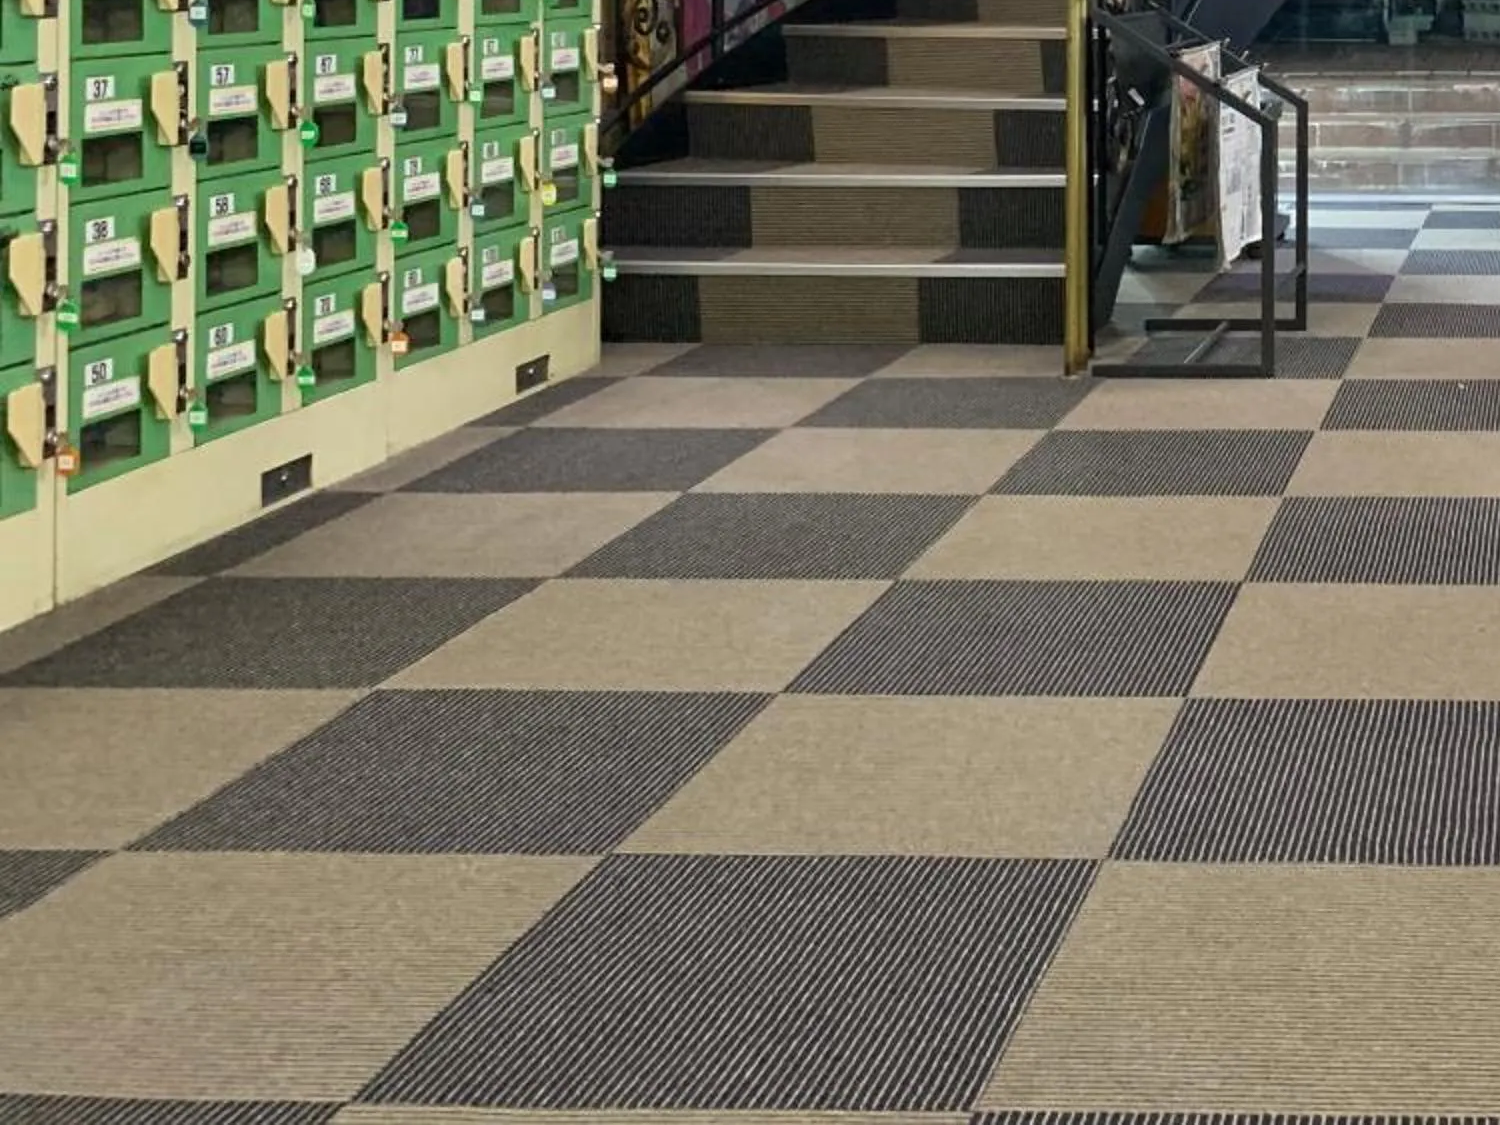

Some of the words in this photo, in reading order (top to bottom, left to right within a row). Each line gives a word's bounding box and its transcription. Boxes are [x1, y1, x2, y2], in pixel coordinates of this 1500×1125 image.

[216, 66, 229, 85] 57
[93, 78, 108, 100] 37
[91, 362, 107, 384] 50
